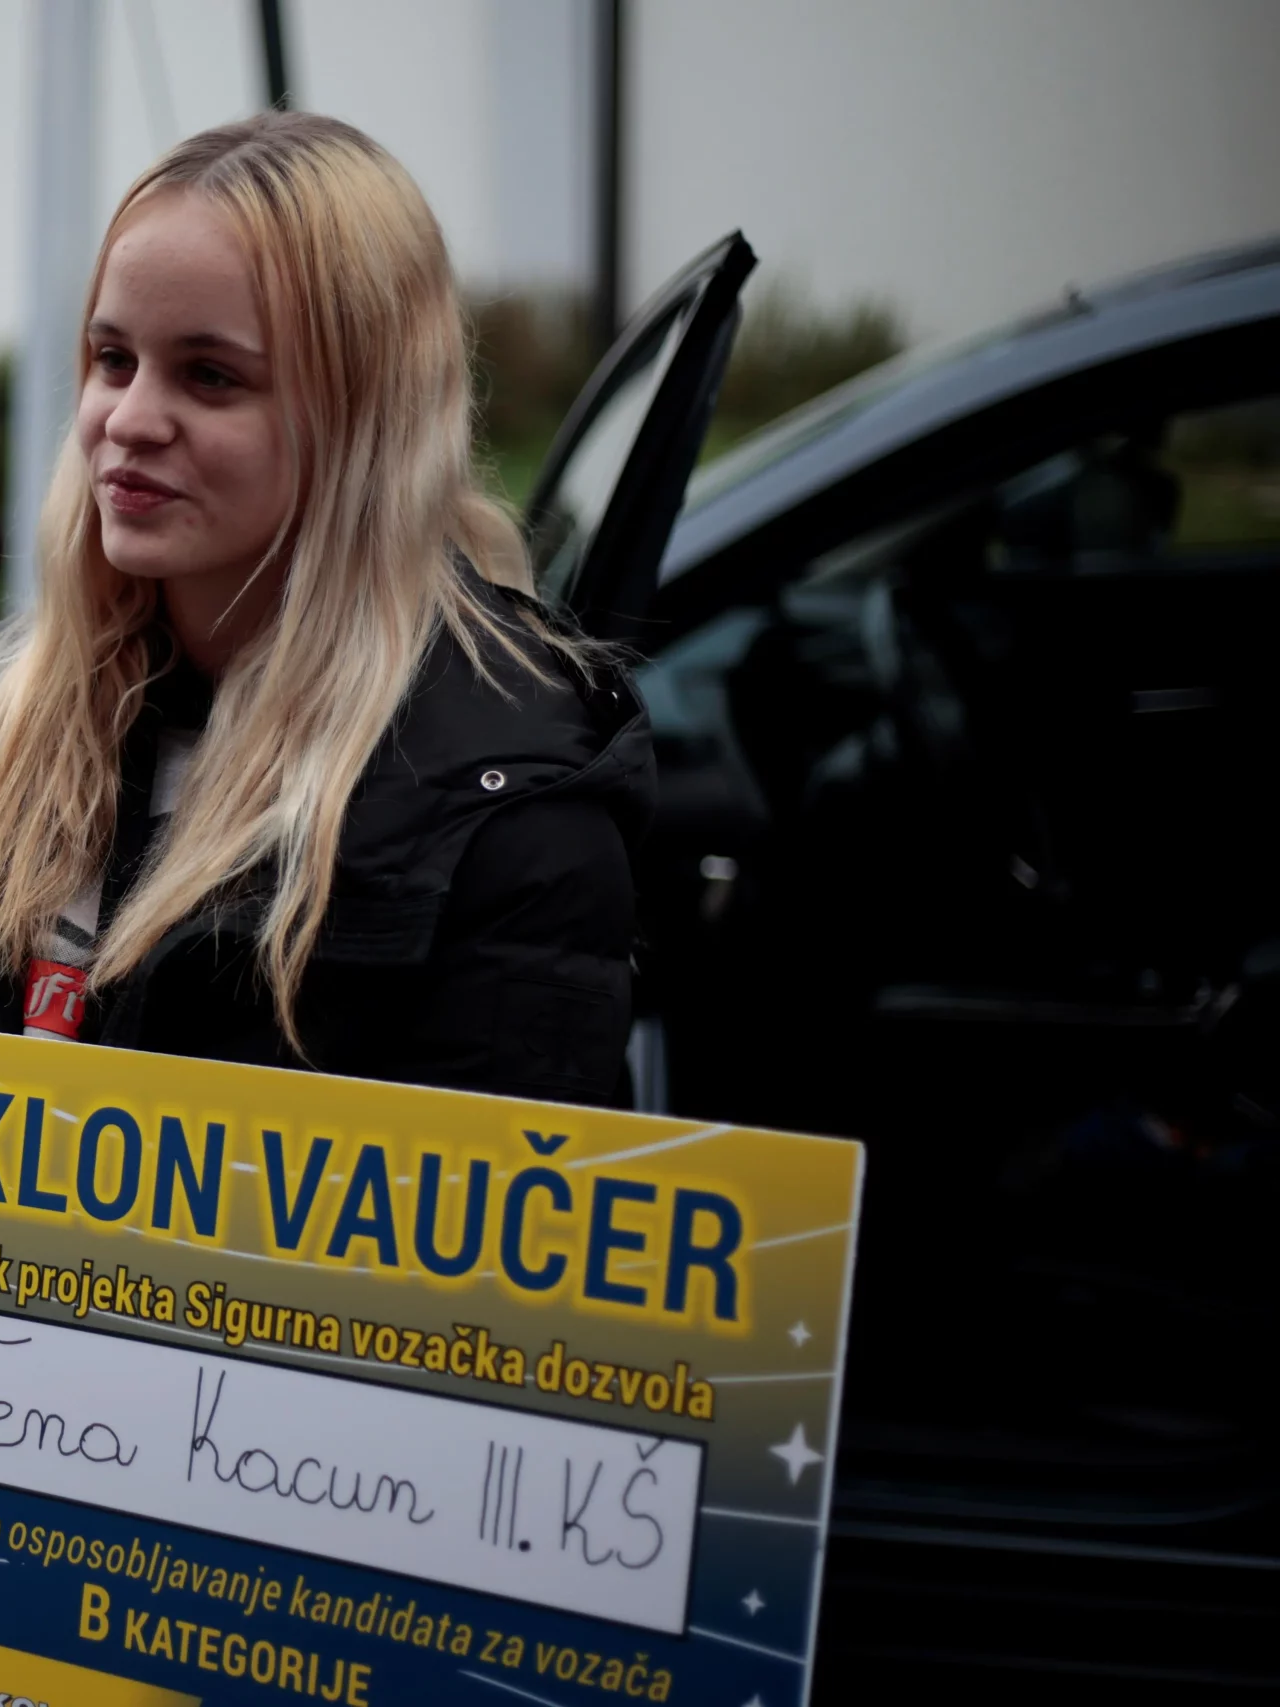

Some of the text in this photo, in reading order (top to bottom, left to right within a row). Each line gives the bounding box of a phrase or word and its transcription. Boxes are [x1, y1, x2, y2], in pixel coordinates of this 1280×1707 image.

[261, 1129, 743, 1321] VAUČER
[17, 1259, 174, 1322] projekta
[185, 1281, 339, 1352] Sigurna
[351, 1320, 525, 1386] vozačka
[535, 1341, 715, 1421] dozvola
[187, 1366, 435, 1525] Kacun
[9, 1520, 281, 1616] osposobljavanje
[289, 1575, 473, 1656] kandidata
[480, 1630, 524, 1668] za
[535, 1641, 673, 1703] vozača
[79, 1583, 372, 1707] B KATEGORIJE
